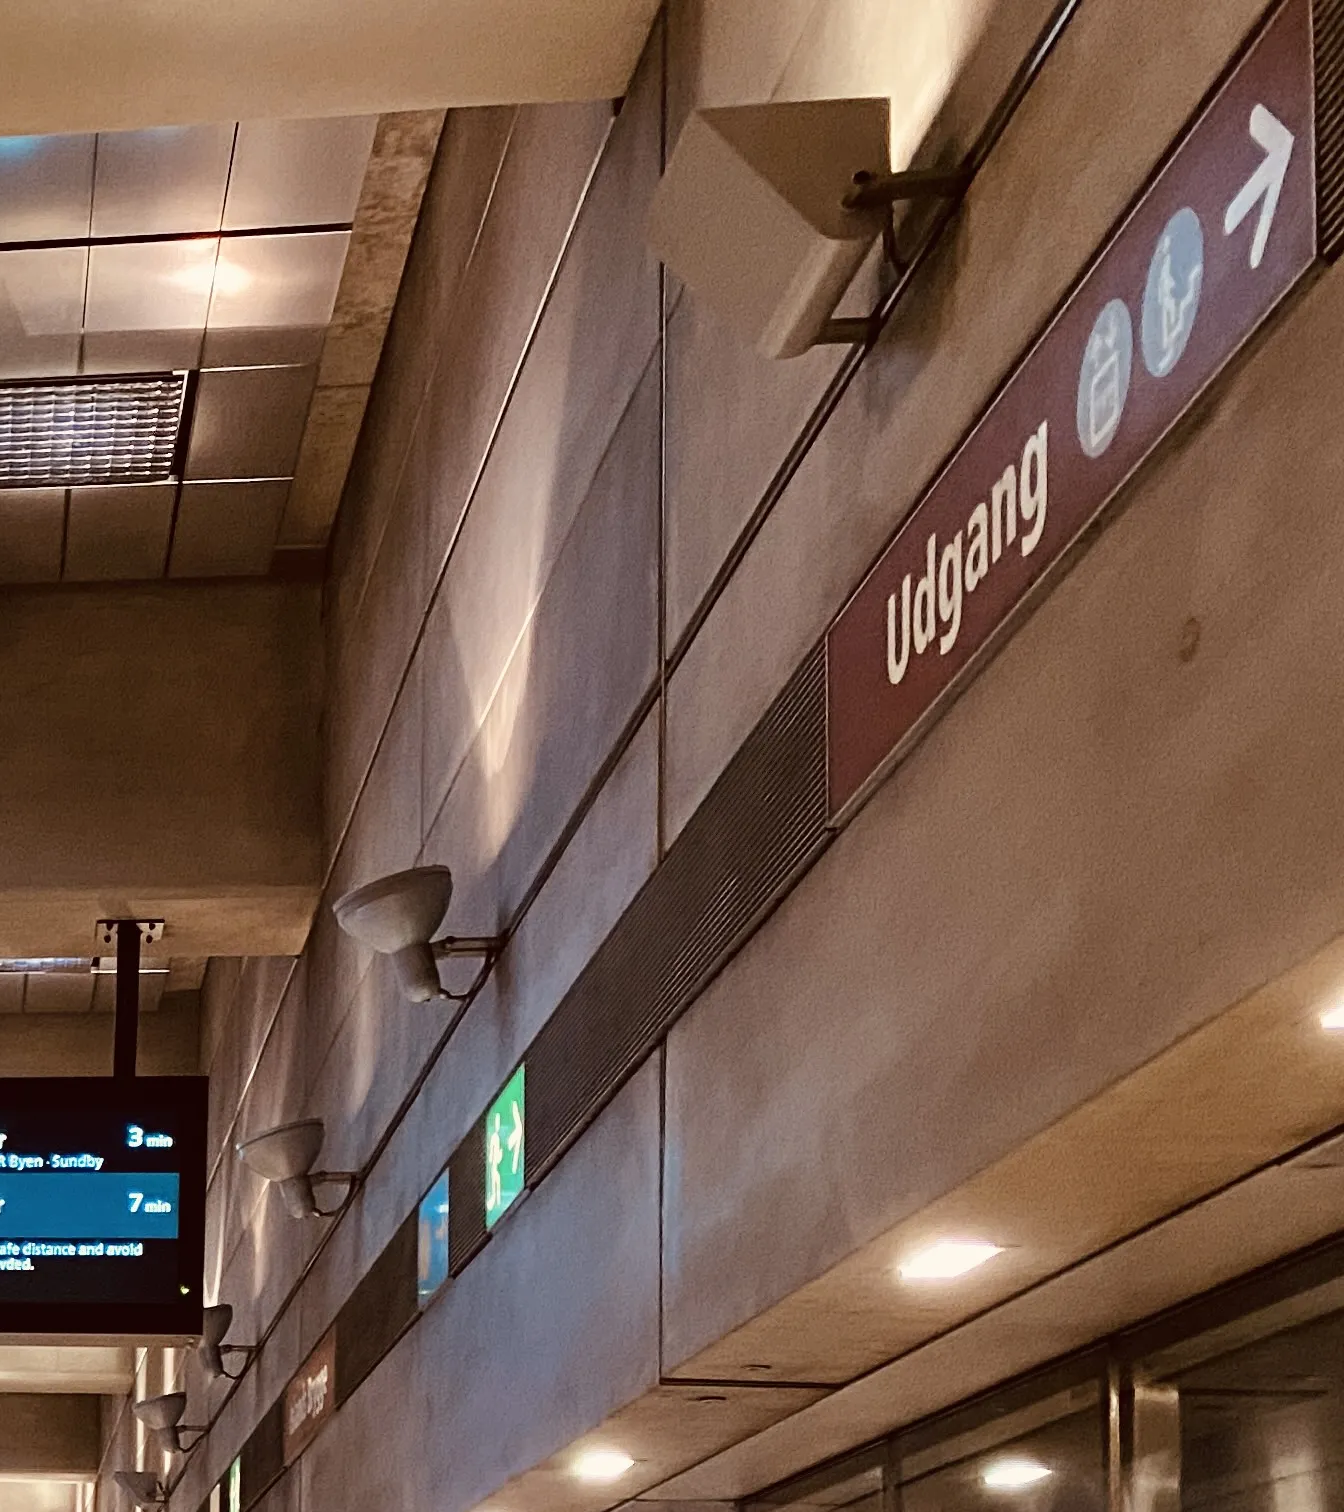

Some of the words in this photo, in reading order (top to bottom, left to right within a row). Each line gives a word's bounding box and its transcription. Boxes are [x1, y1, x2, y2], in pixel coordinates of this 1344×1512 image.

[887, 420, 1048, 684] Udgang
[127, 1126, 144, 1148] 3
[146, 1134, 173, 1148] min
[9, 1154, 43, 1171] Byen
[51, 1154, 104, 1171] Sundby
[128, 1192, 144, 1213] 7
[144, 1200, 172, 1213] min
[22, 1242, 76, 1256] distance
[78, 1243, 104, 1256] and
[106, 1243, 143, 1256] avoid
